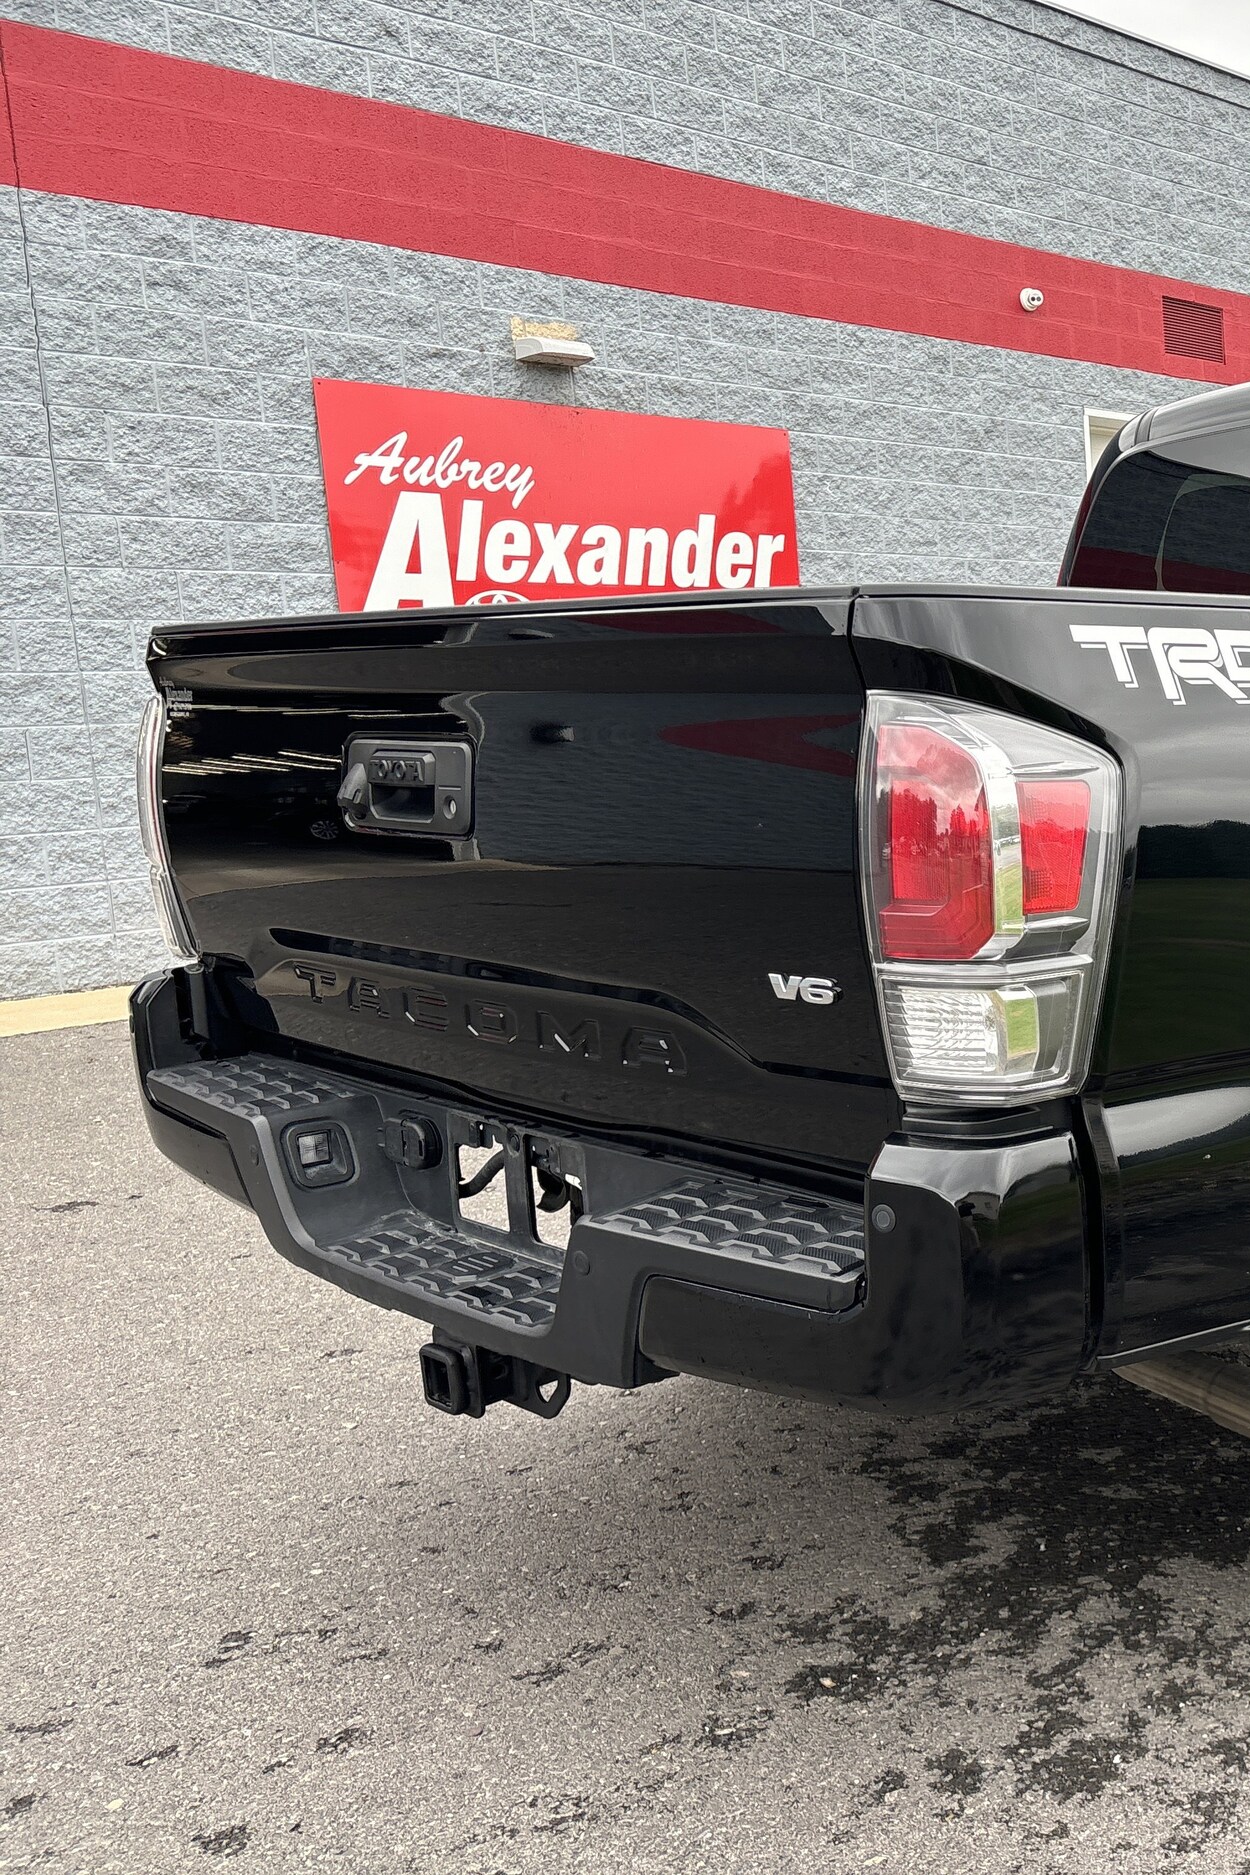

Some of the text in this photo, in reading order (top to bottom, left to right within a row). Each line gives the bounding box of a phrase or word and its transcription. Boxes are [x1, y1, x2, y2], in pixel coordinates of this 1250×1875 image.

[344, 430, 535, 510] Aubrey
[362, 490, 785, 612] Alexander
[294, 962, 688, 1076] TACOMA
[768, 973, 841, 1005] V6
